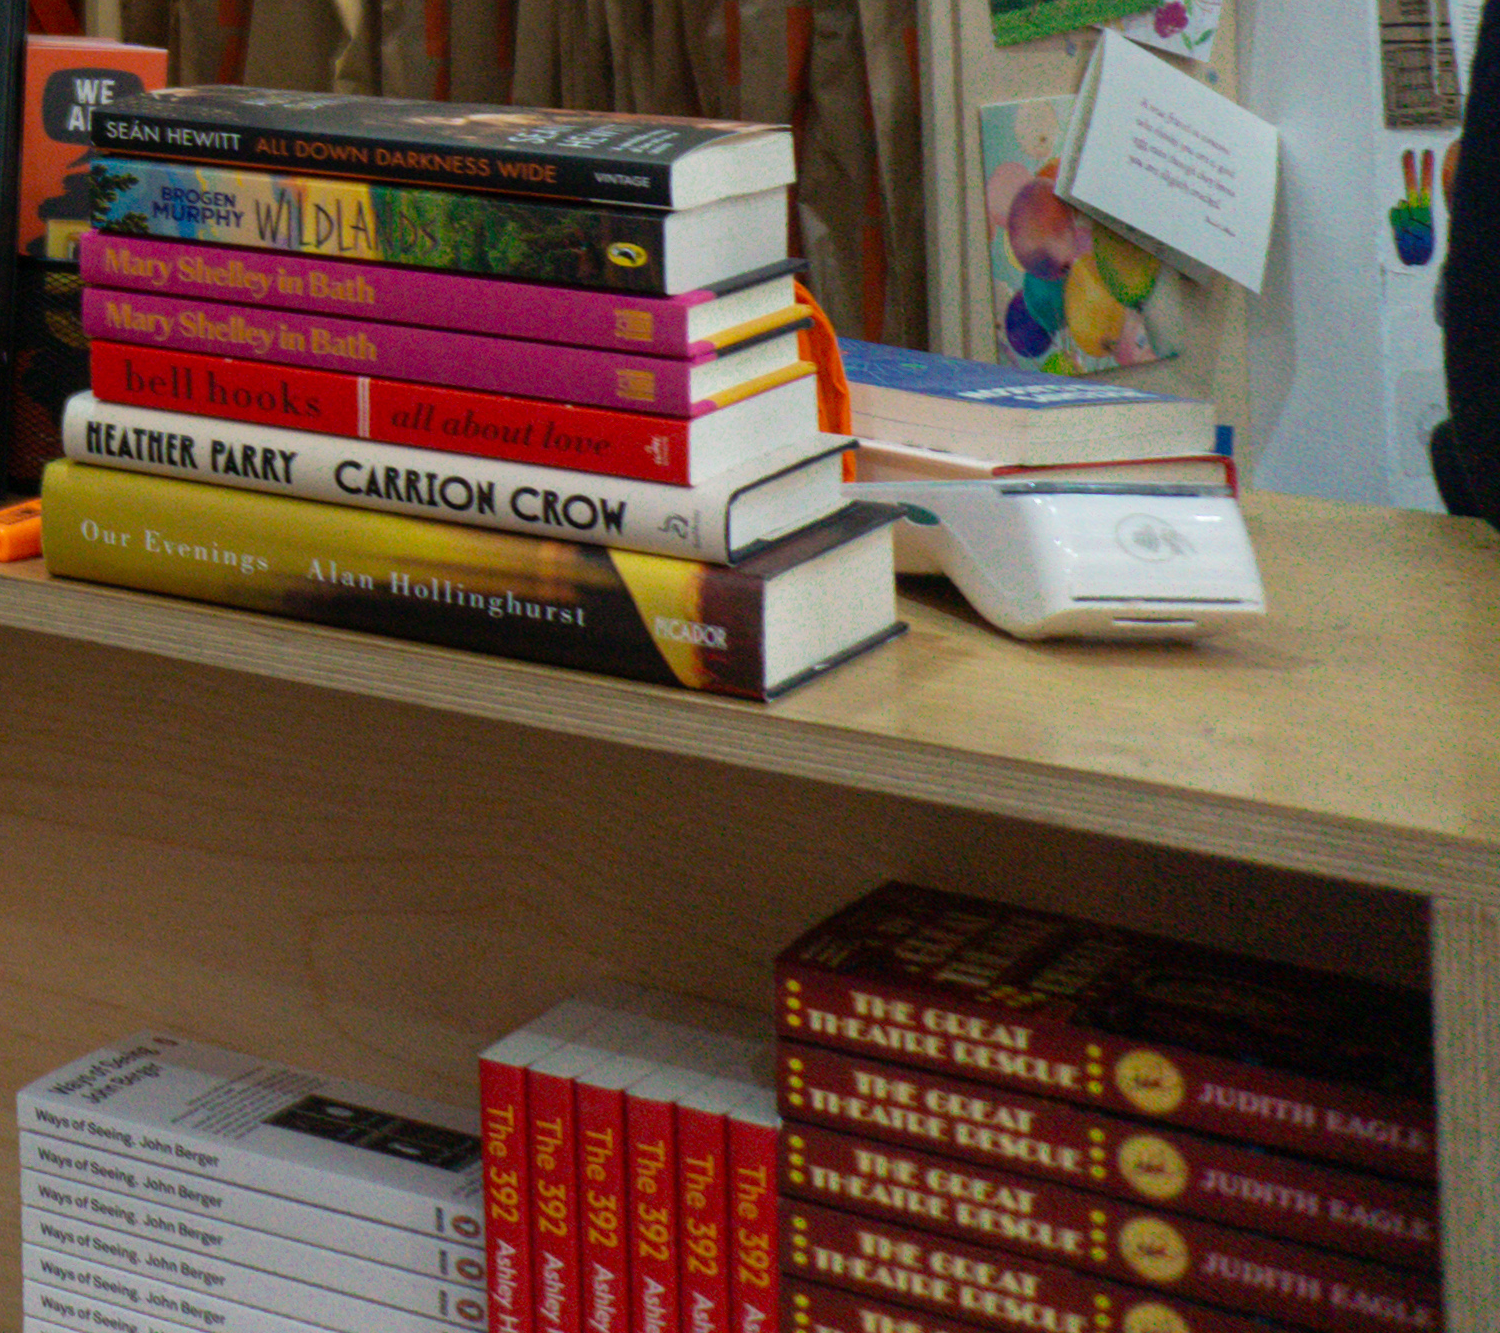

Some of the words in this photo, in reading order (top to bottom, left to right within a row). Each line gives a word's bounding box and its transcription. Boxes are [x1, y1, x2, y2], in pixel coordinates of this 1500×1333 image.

[74, 80, 115, 103] WE
[106, 119, 163, 144] SEÁN
[167, 125, 240, 152] HEWITT
[255, 137, 290, 158] ALL
[295, 139, 368, 166] DOWN
[375, 147, 490, 178] DARKNESS
[496, 158, 558, 184] WIDE
[594, 170, 651, 189] VINTAGE
[152, 202, 245, 229] MURPHY
[161, 185, 236, 208] BROGEN
[255, 189, 438, 254] WILDLANDS
[105, 248, 170, 286] Mary
[178, 254, 273, 301] Shelley
[279, 267, 301, 296] in
[309, 269, 375, 305] Bath
[106, 301, 173, 340] Mary
[179, 308, 274, 354] Shelley
[280, 322, 303, 352] in
[310, 326, 378, 363] Bath
[123, 361, 193, 403] bell
[208, 366, 321, 419] hooks
[391, 403, 437, 434] all
[440, 406, 535, 451] about
[540, 417, 611, 456] love
[87, 420, 199, 470] HEATHER
[210, 440, 298, 485] PARRY
[334, 460, 496, 515] CARRION
[511, 486, 627, 536] CROW
[79, 520, 131, 549] Our
[145, 530, 272, 574] Evenings
[307, 558, 376, 591] Alan
[390, 573, 587, 628] Hollinghurst
[653, 617, 727, 650] PICADOR
[808, 1009, 946, 1061] THEATRE
[953, 1040, 1082, 1092] RESCUE
[853, 991, 913, 1026] THE
[923, 1008, 1032, 1052] GREAT
[488, 1105, 514, 1157] The
[1199, 1083, 1317, 1129] JUDITH
[34, 1108, 70, 1130] Ways
[72, 1119, 86, 1132] of
[87, 1121, 137, 1148] Seeing.
[139, 1135, 173, 1155] John
[175, 1144, 220, 1168] Berger
[490, 1167, 519, 1223] 392
[494, 1240, 517, 1308] Ashley
